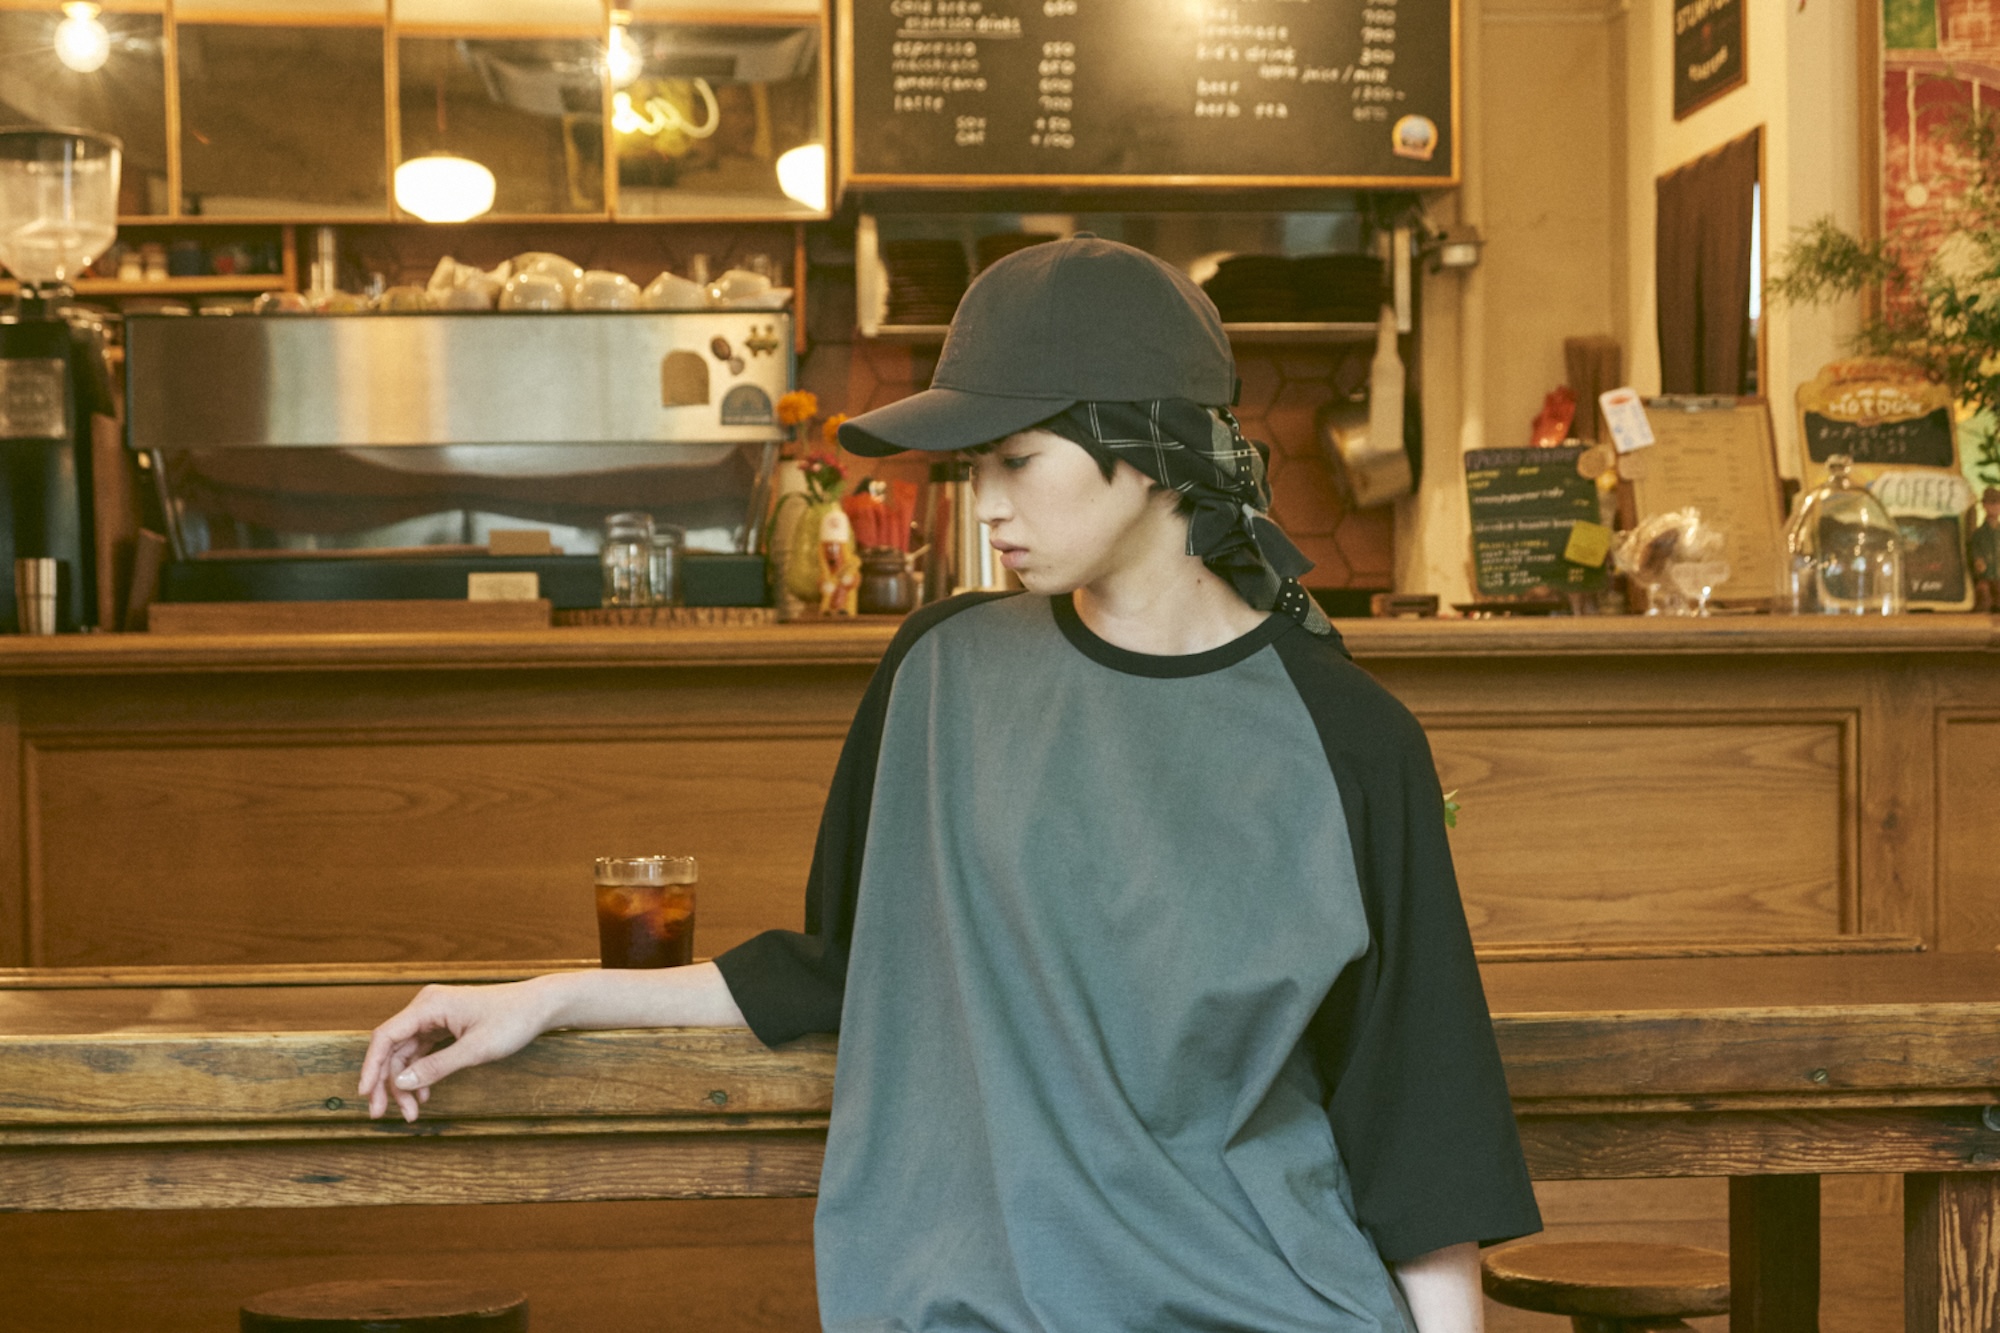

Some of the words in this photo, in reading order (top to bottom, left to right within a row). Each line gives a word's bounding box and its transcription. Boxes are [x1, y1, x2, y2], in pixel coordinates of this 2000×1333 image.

[892, 41, 976, 58] espresso
[893, 73, 987, 92] americano
[1196, 77, 1240, 96] beer
[894, 95, 945, 113] latte
[1880, 478, 1956, 511] COFFEE
